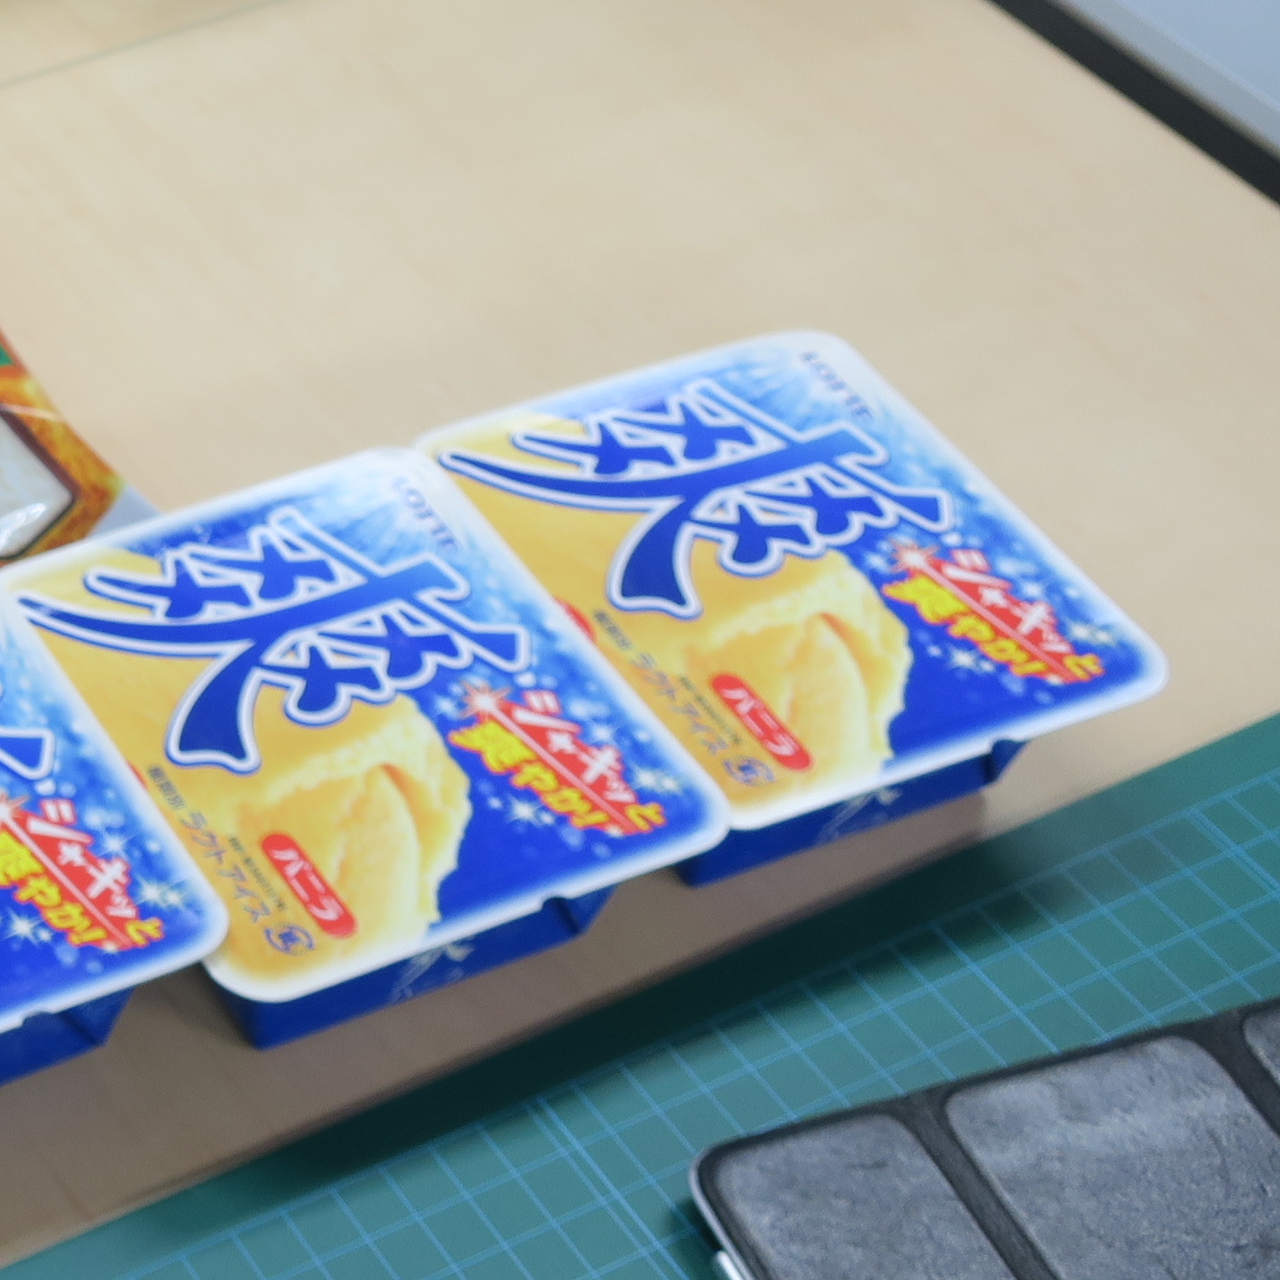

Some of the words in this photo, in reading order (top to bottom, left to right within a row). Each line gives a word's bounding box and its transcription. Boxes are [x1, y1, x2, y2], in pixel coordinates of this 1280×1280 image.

[439, 377, 954, 620] 爽
[12, 506, 529, 776] 爽
[718, 682, 804, 762] バニラ
[22, 797, 168, 952] シャキッと
[268, 842, 351, 931] バニラ
